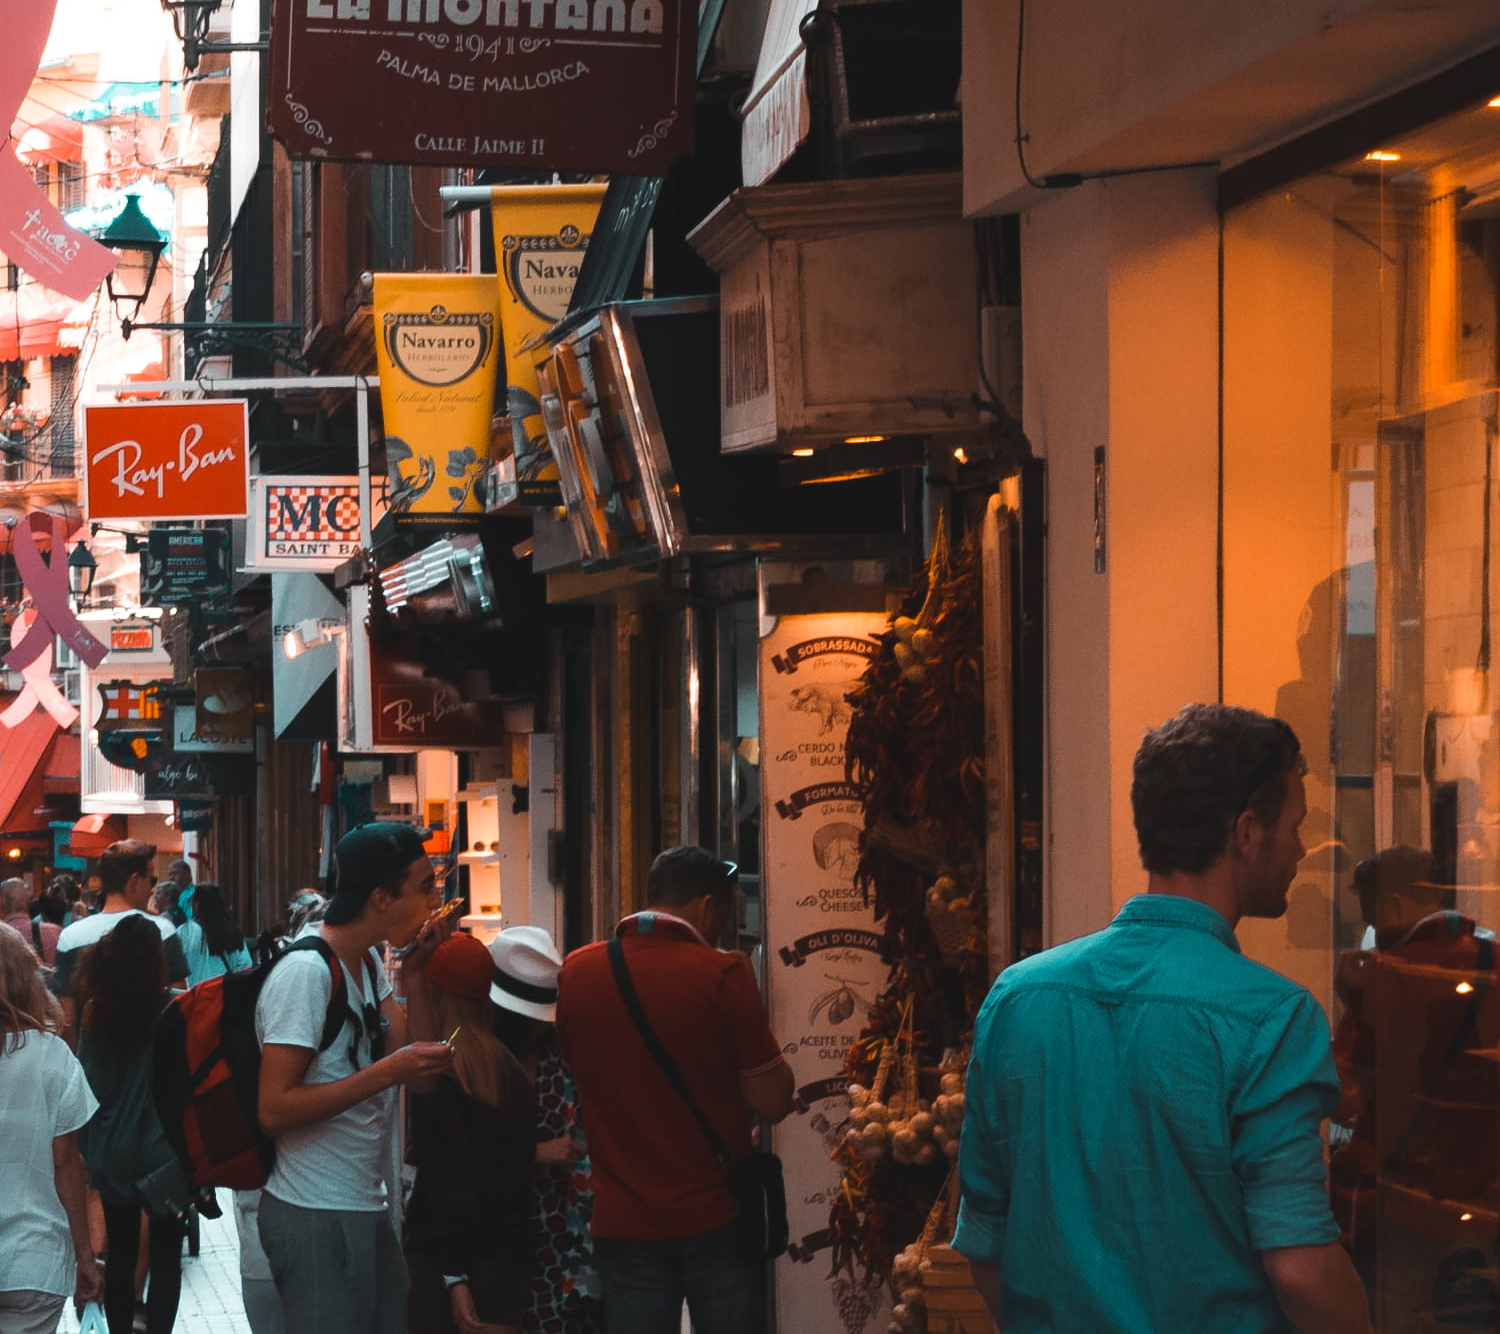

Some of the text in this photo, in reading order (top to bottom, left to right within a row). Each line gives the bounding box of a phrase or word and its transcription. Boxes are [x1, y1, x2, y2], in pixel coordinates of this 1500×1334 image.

[455, 34, 516, 63] 1941
[377, 48, 590, 93] PALMA DE MALLORCA
[414, 133, 467, 153] CALLE
[473, 135, 526, 157] JAIME
[525, 259, 579, 280] Nava
[402, 332, 476, 350] Navarro
[92, 423, 236, 499] Ray-Ban
[275, 543, 331, 555] SAINT
[798, 639, 873, 658] SOBRASSADA
[798, 743, 835, 754] CERDO
[810, 755, 845, 767] BLACK
[820, 901, 864, 913] CHEESE
[808, 937, 828, 951] OLI
[799, 1035, 856, 1047] ACEITE DE
